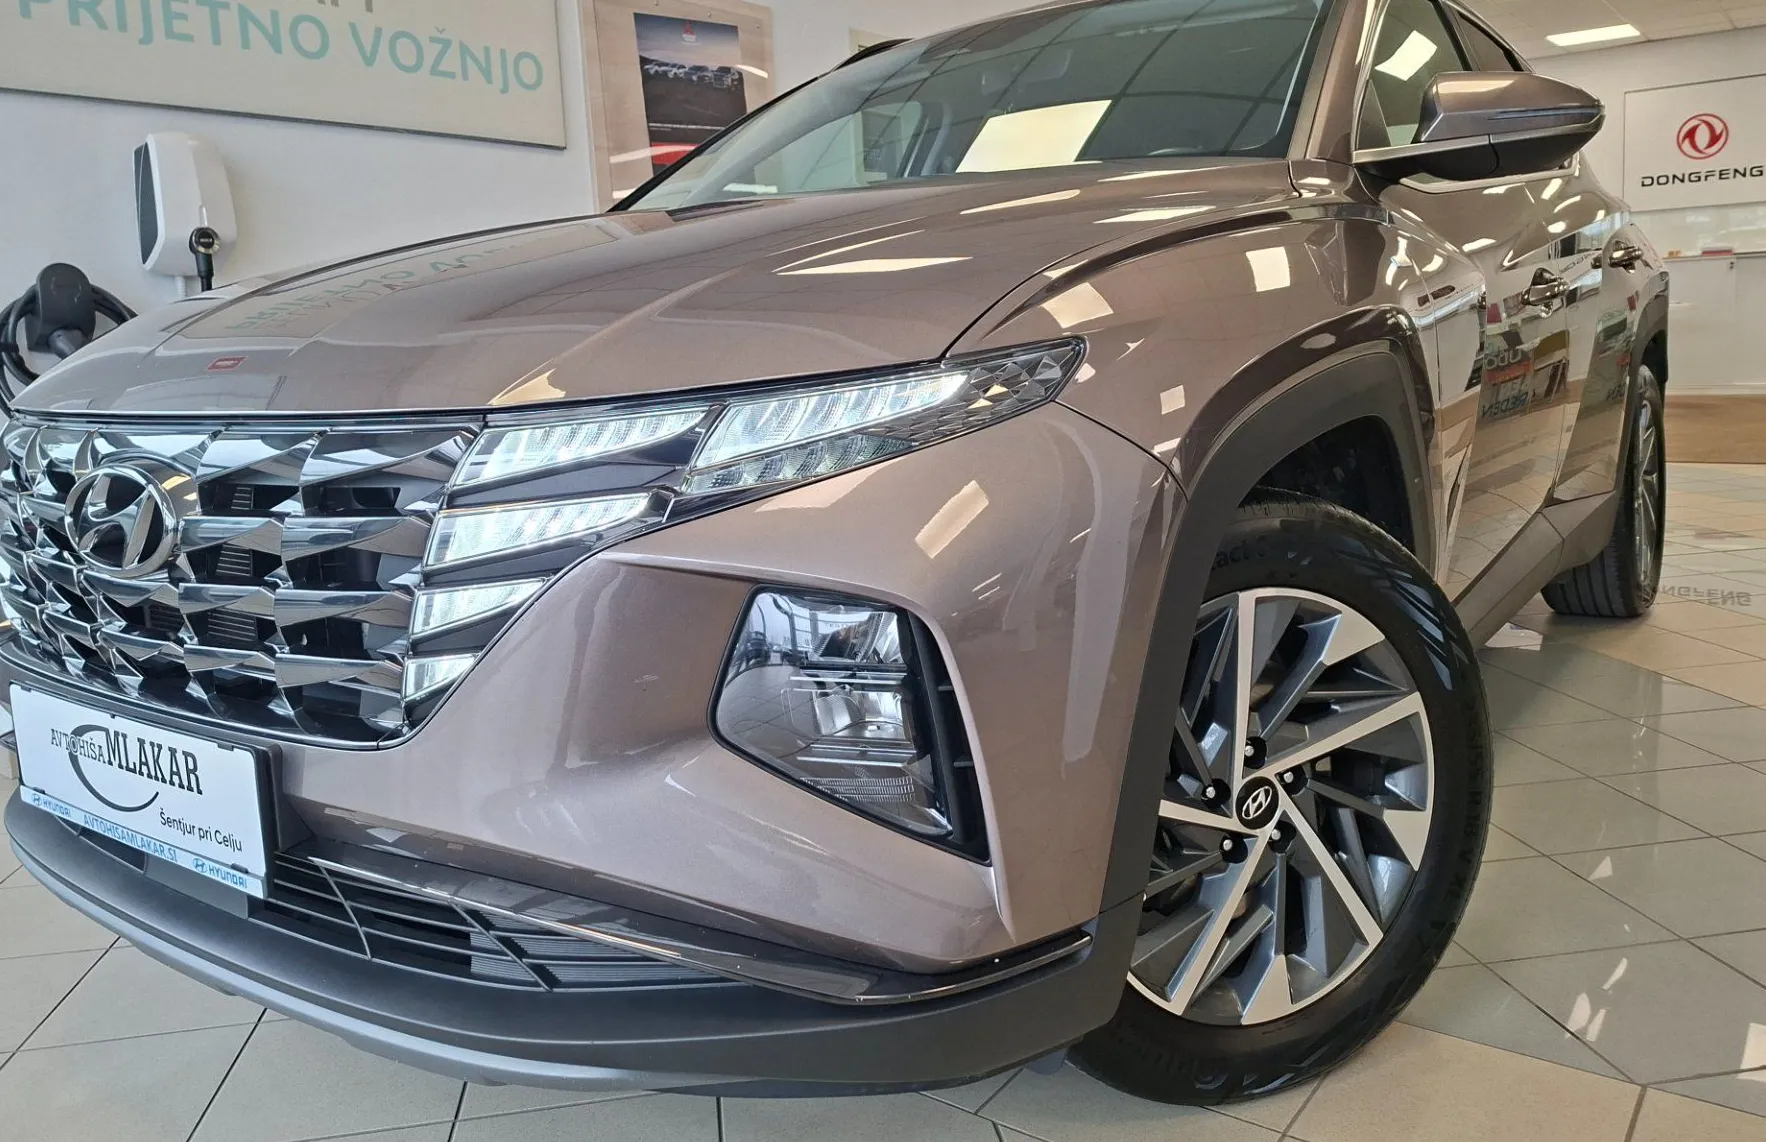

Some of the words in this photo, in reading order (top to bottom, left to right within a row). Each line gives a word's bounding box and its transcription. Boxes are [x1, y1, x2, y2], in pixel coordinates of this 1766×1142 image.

[348, 26, 543, 94] VOŽNJO
[1641, 165, 1764, 187] DONGFENG
[107, 730, 203, 795] MLAKAR
[83, 814, 178, 863] AVTOHISAMLAKAR.SI
[160, 807, 195, 836] Šentjur
[198, 826, 212, 841] pri
[214, 829, 242, 852] Celju
[208, 864, 248, 890] HYUNDAI
